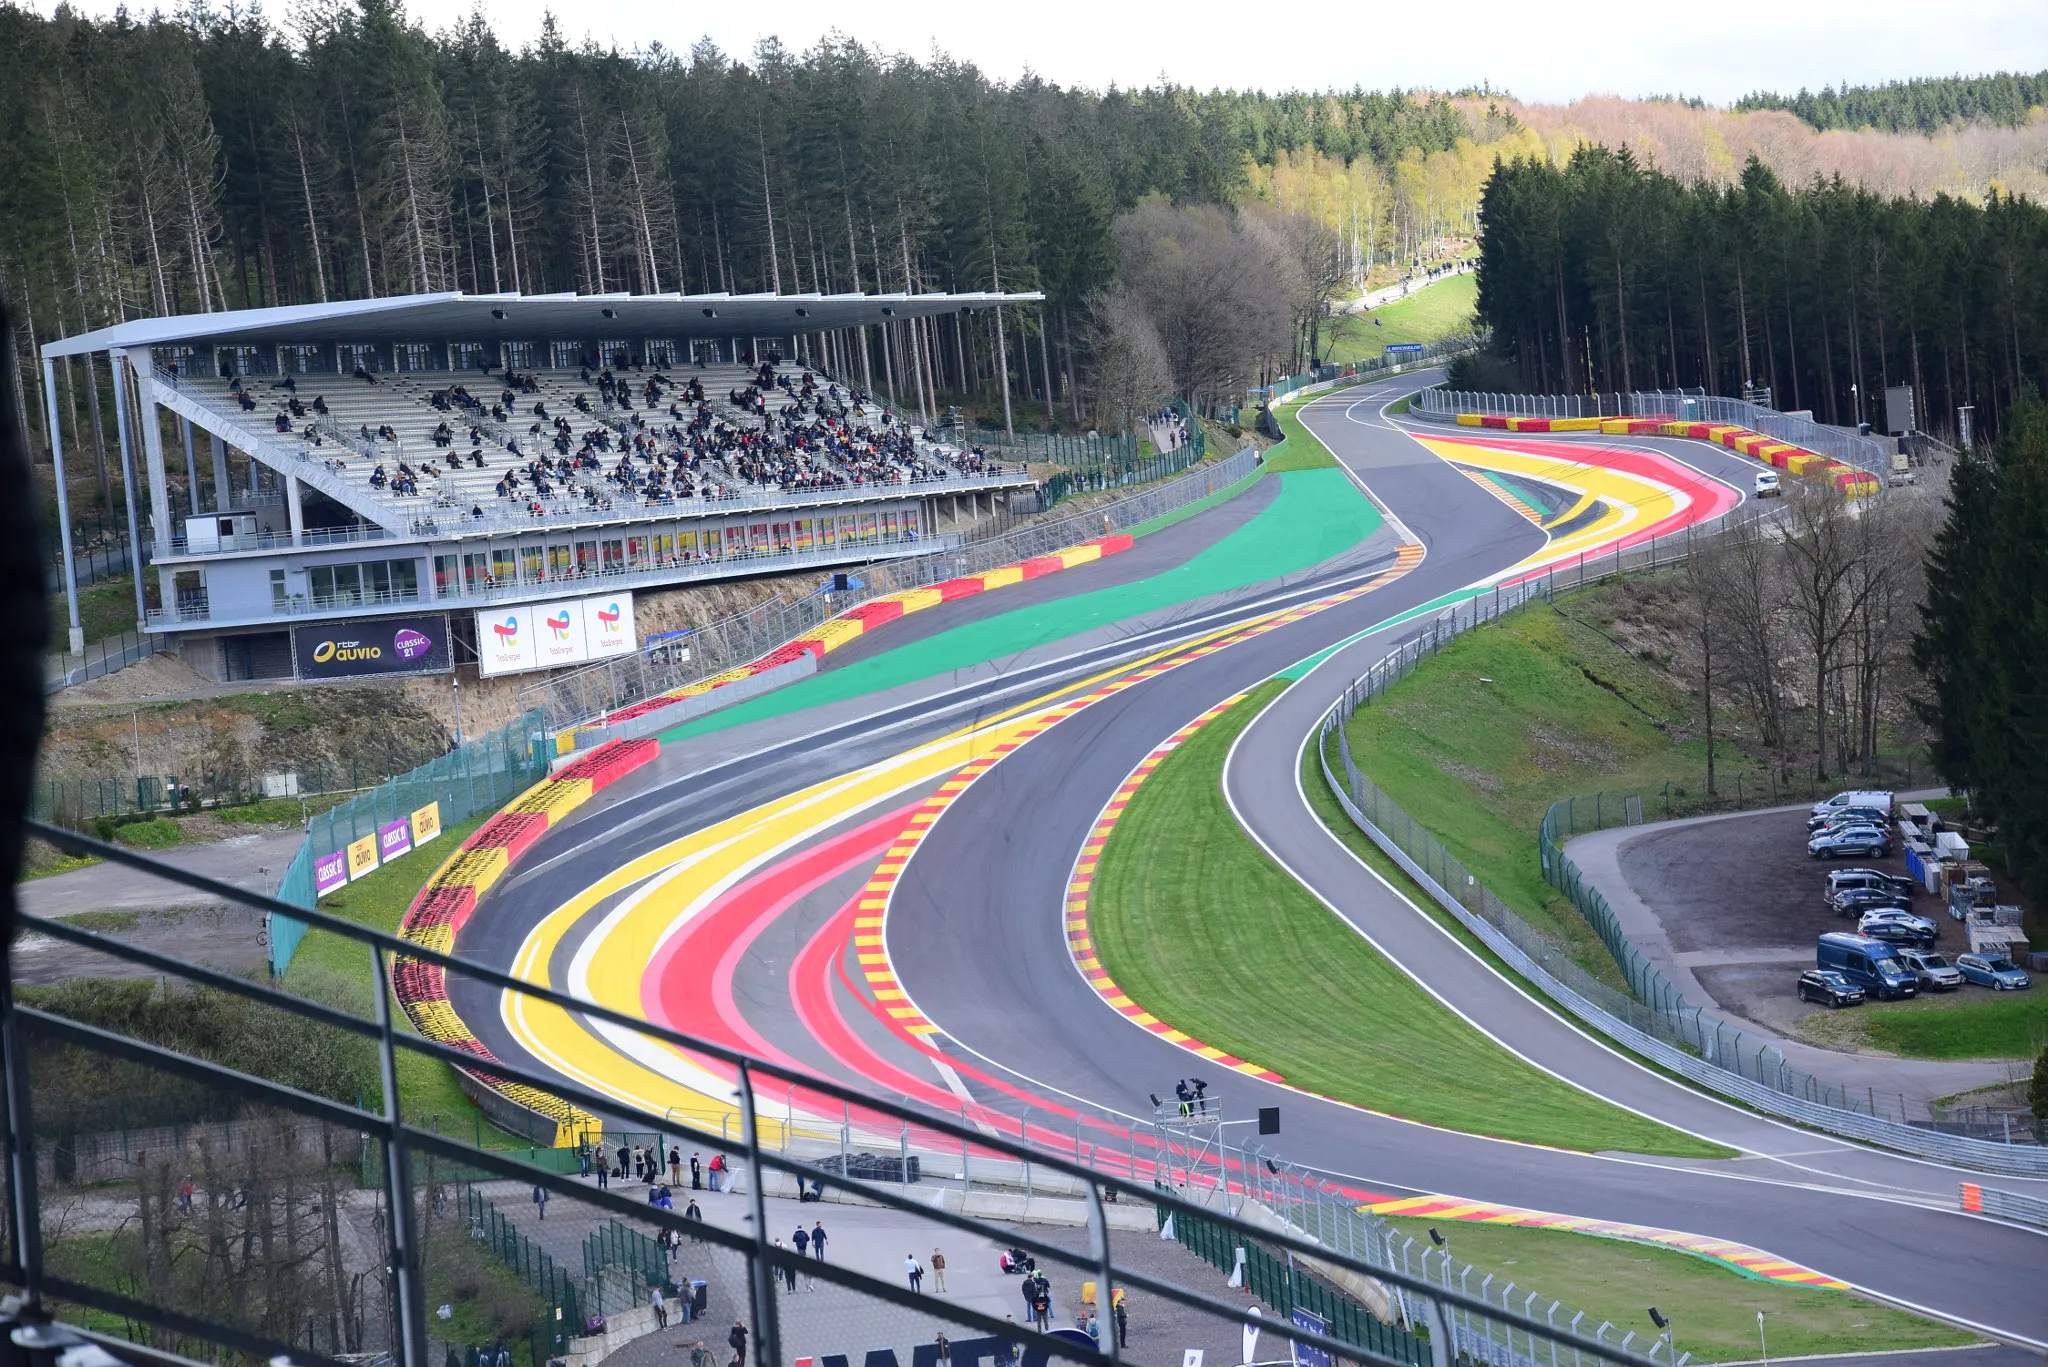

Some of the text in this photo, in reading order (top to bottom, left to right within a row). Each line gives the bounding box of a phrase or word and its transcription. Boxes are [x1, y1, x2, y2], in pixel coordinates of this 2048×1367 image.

[396, 638, 425, 650] CLASSIC
[404, 648, 414, 658] 21
[383, 828, 400, 848] CLASSIC
[318, 861, 336, 882] CLASSIC
